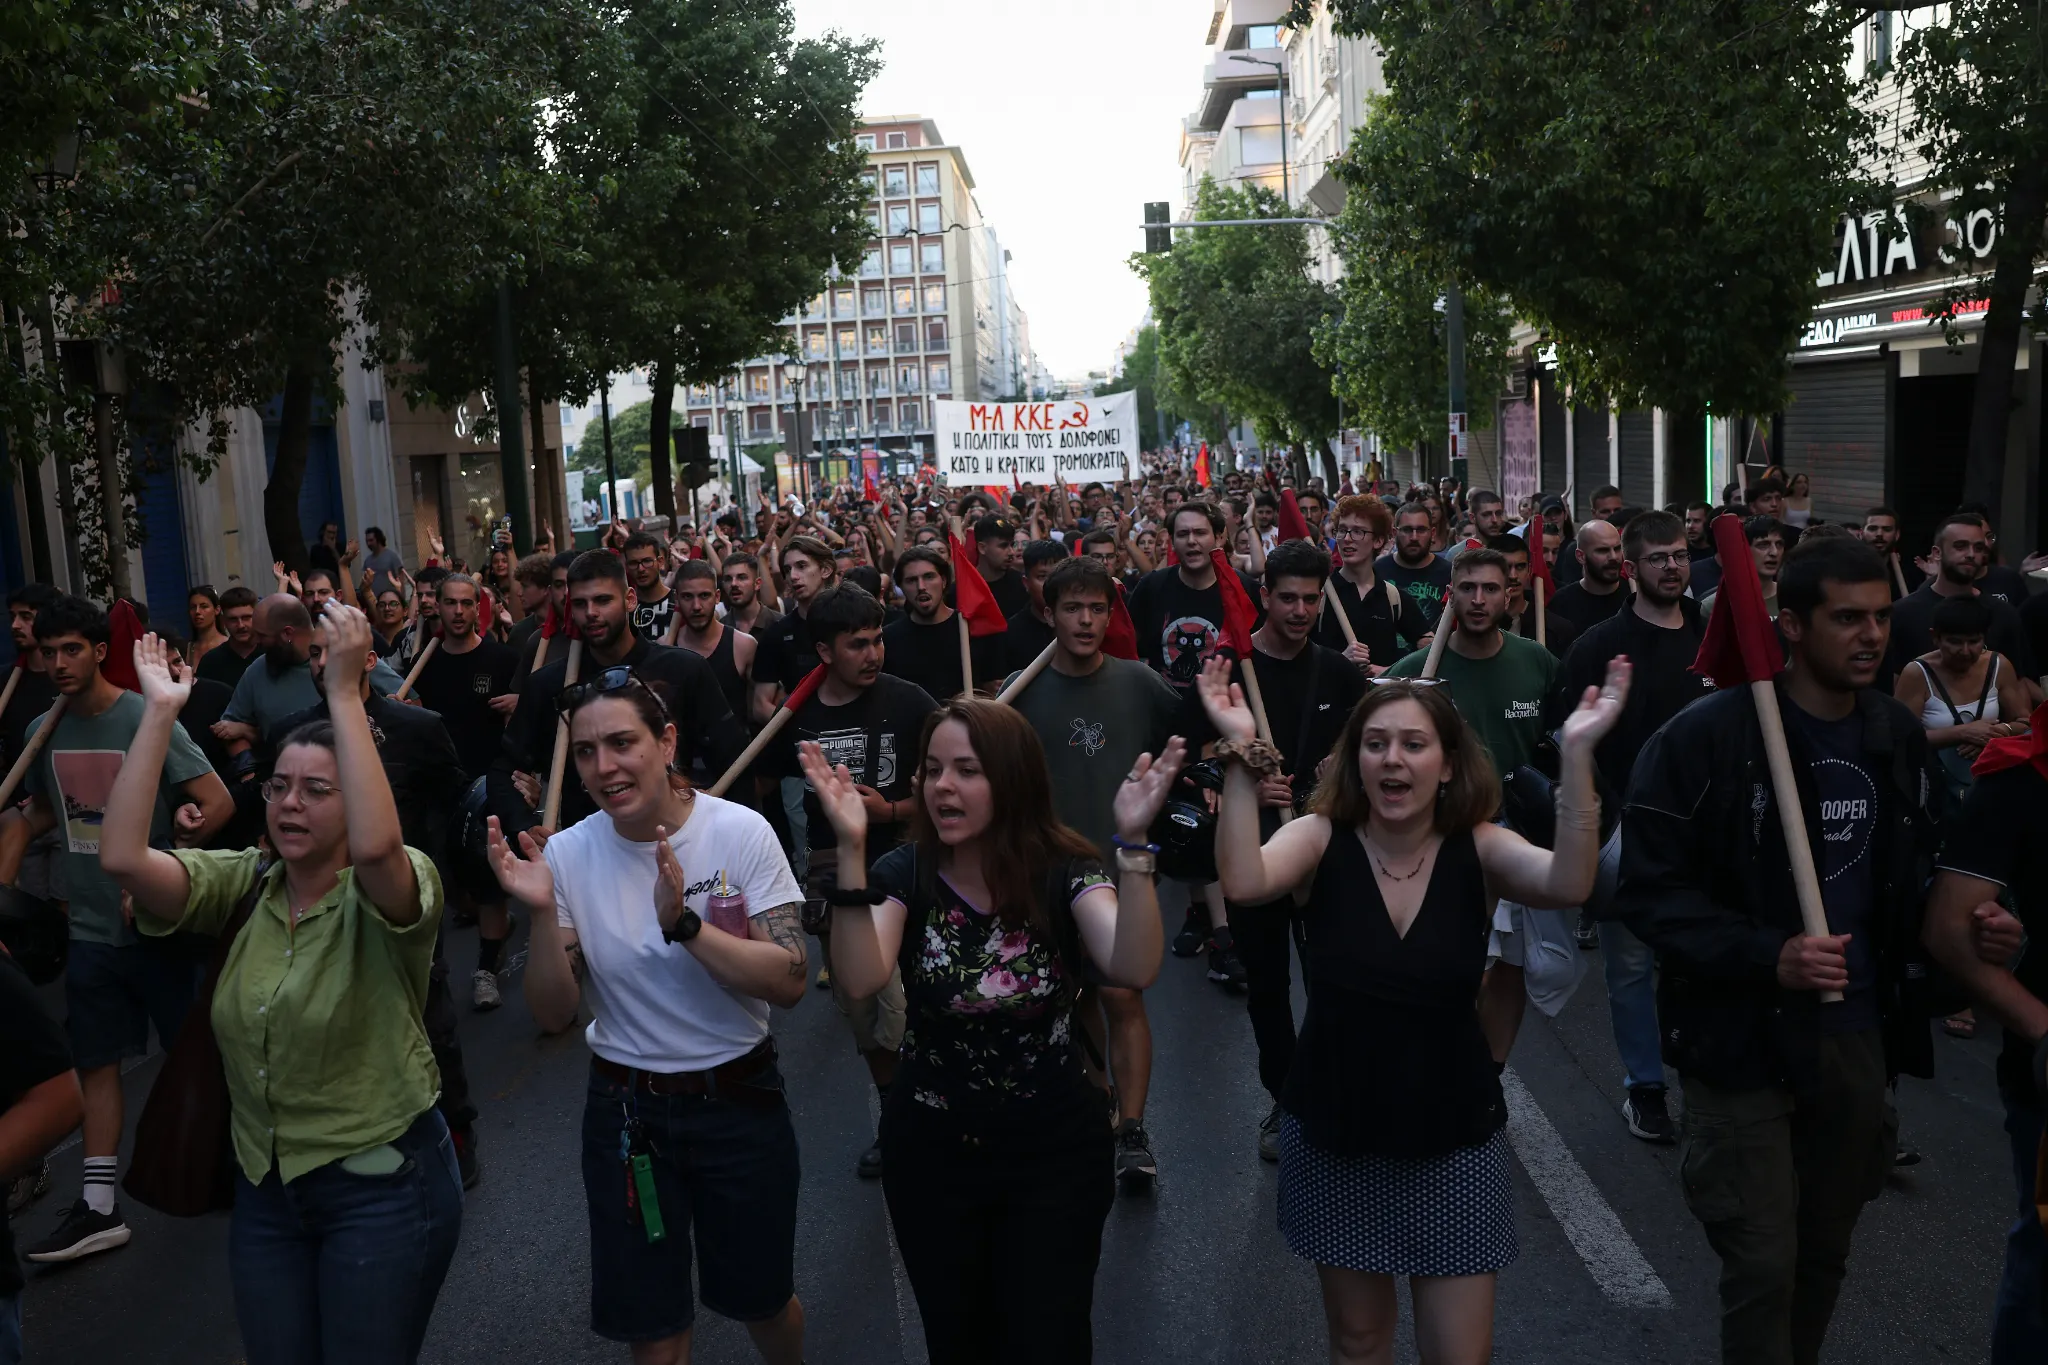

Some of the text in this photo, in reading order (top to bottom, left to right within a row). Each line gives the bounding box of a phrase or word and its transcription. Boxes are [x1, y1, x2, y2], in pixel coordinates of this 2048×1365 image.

[1816, 204, 1917, 287] ΛΤΑ
[970, 404, 1054, 430] Μ-Λ ΚΚΕ
[953, 429, 1120, 449] Η ΠΟΛΙΤΙΚΗ ΤΟΥΣ ΔΟΛΟΦΟΝΕΙ
[951, 456, 980, 475] ΚΑΤΩ
[986, 457, 993, 474] Η
[998, 456, 1045, 474] ΚΡΑΤΙΚΗ
[1504, 708, 1531, 719] Racquet
[829, 738, 854, 749] PUMA
[1820, 799, 1868, 820] OOPER
[72, 841, 98, 850] FNKY
